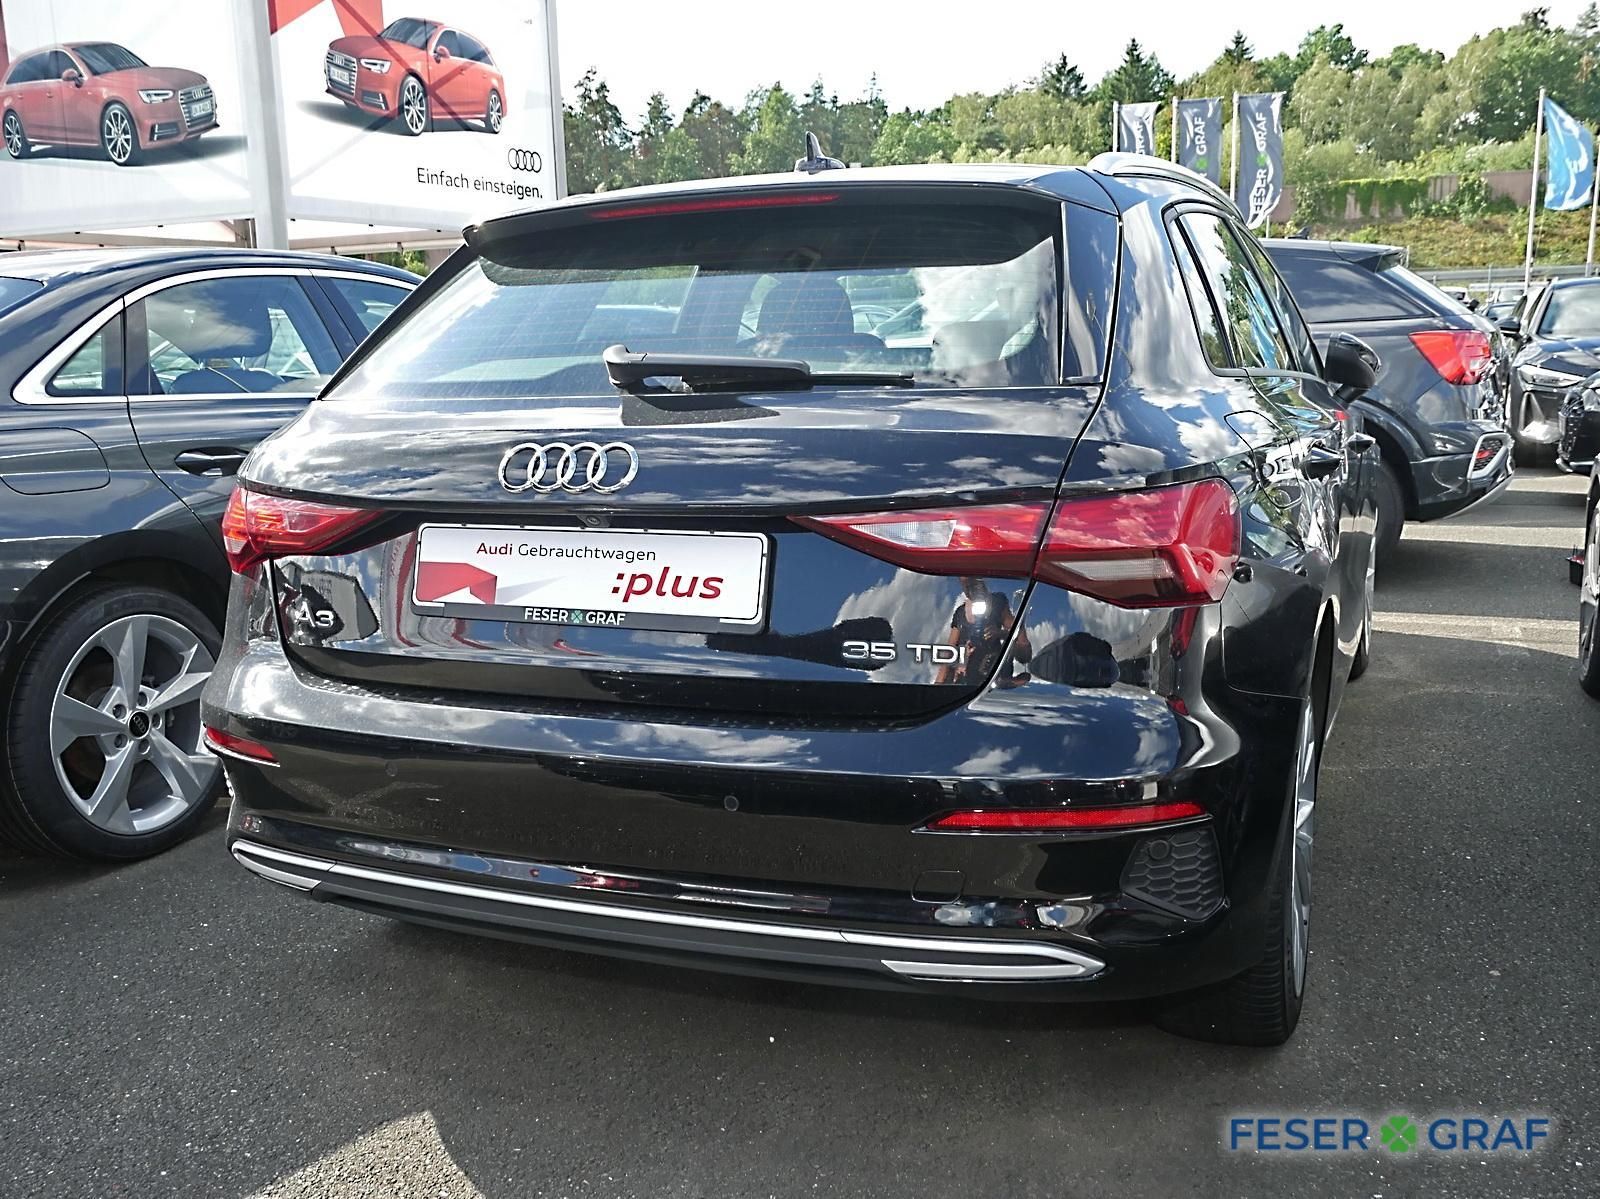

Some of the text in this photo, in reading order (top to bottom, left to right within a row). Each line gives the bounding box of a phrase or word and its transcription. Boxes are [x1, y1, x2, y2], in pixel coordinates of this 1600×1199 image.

[1194, 116, 1207, 155] GRAF
[1256, 112, 1267, 151] GRAF
[417, 167, 543, 200] Einfach einsteigen.
[476, 541, 657, 564] Audi Gebrauchtwagen
[611, 566, 724, 603] :plus
[295, 600, 335, 628] A3
[524, 607, 627, 627] FESER GRAF
[842, 640, 966, 665] 35 TDI
